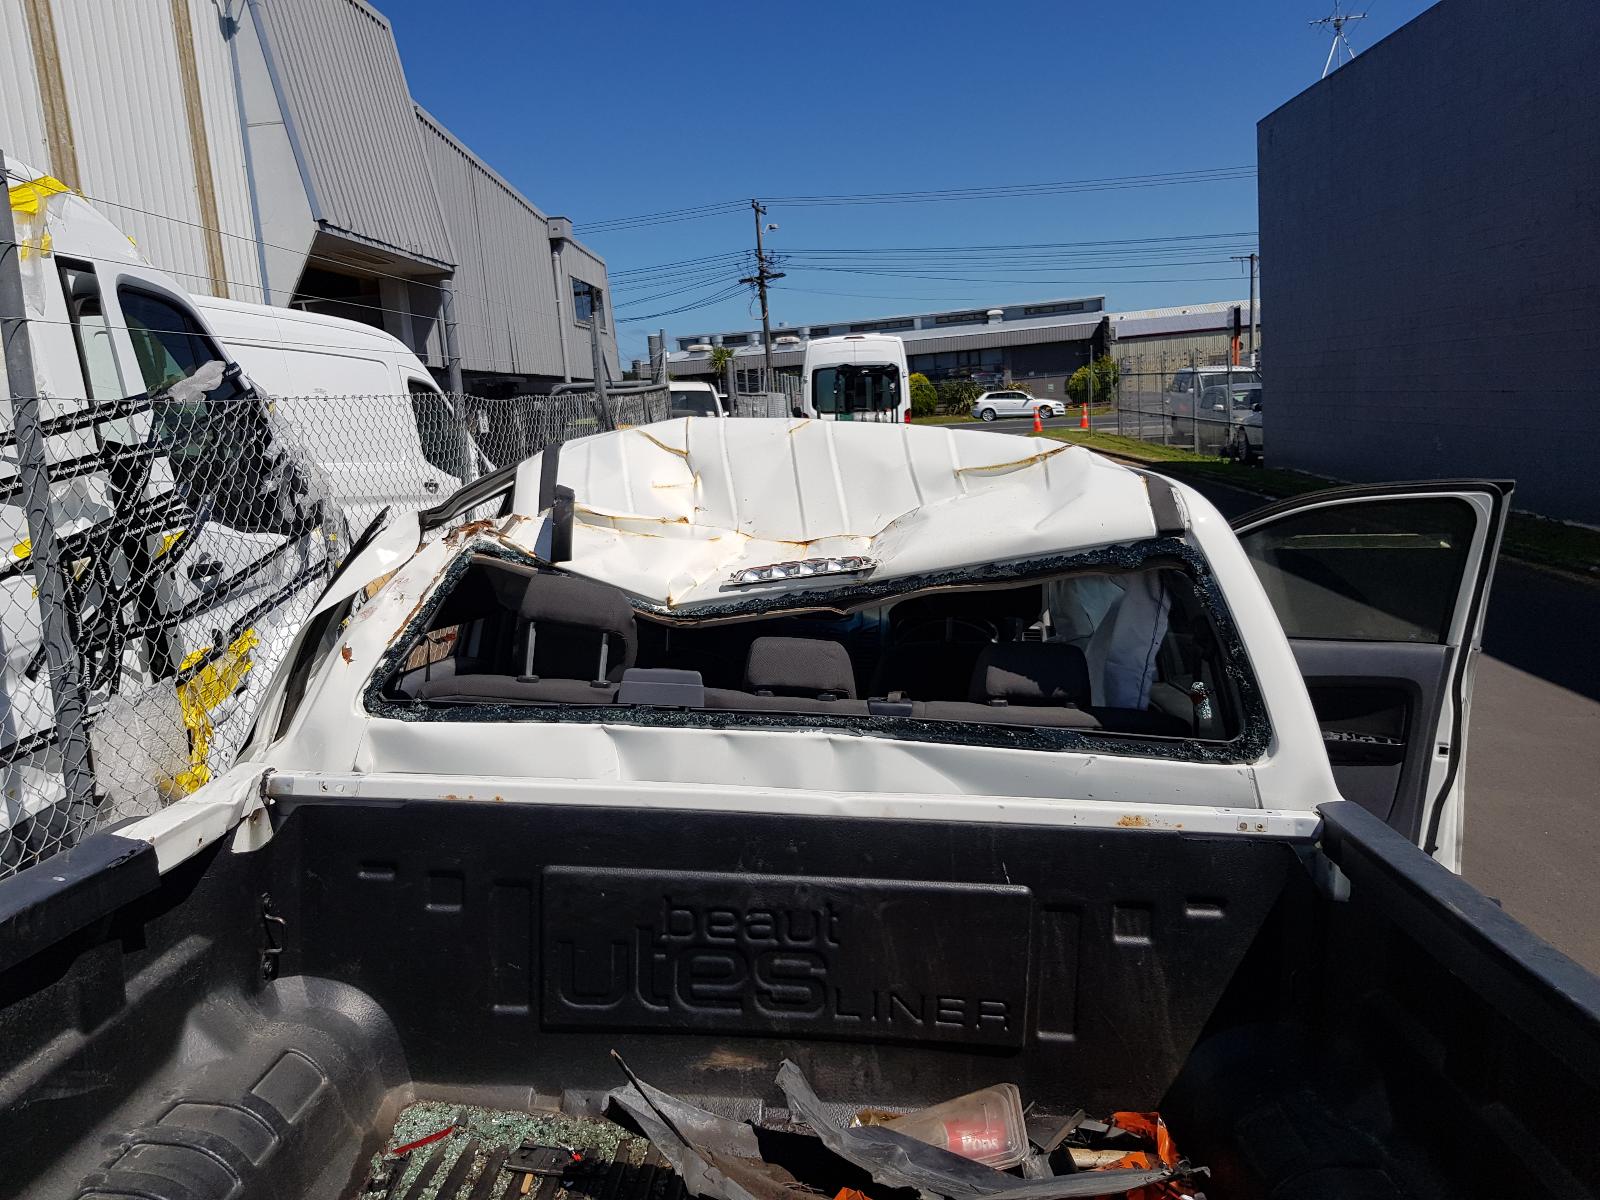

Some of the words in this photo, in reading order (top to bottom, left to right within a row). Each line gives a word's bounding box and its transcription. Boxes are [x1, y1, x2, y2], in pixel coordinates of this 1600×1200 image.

[661, 895, 840, 947] beaut
[556, 925, 826, 1019] utes
[833, 988, 1009, 1031] LINER
